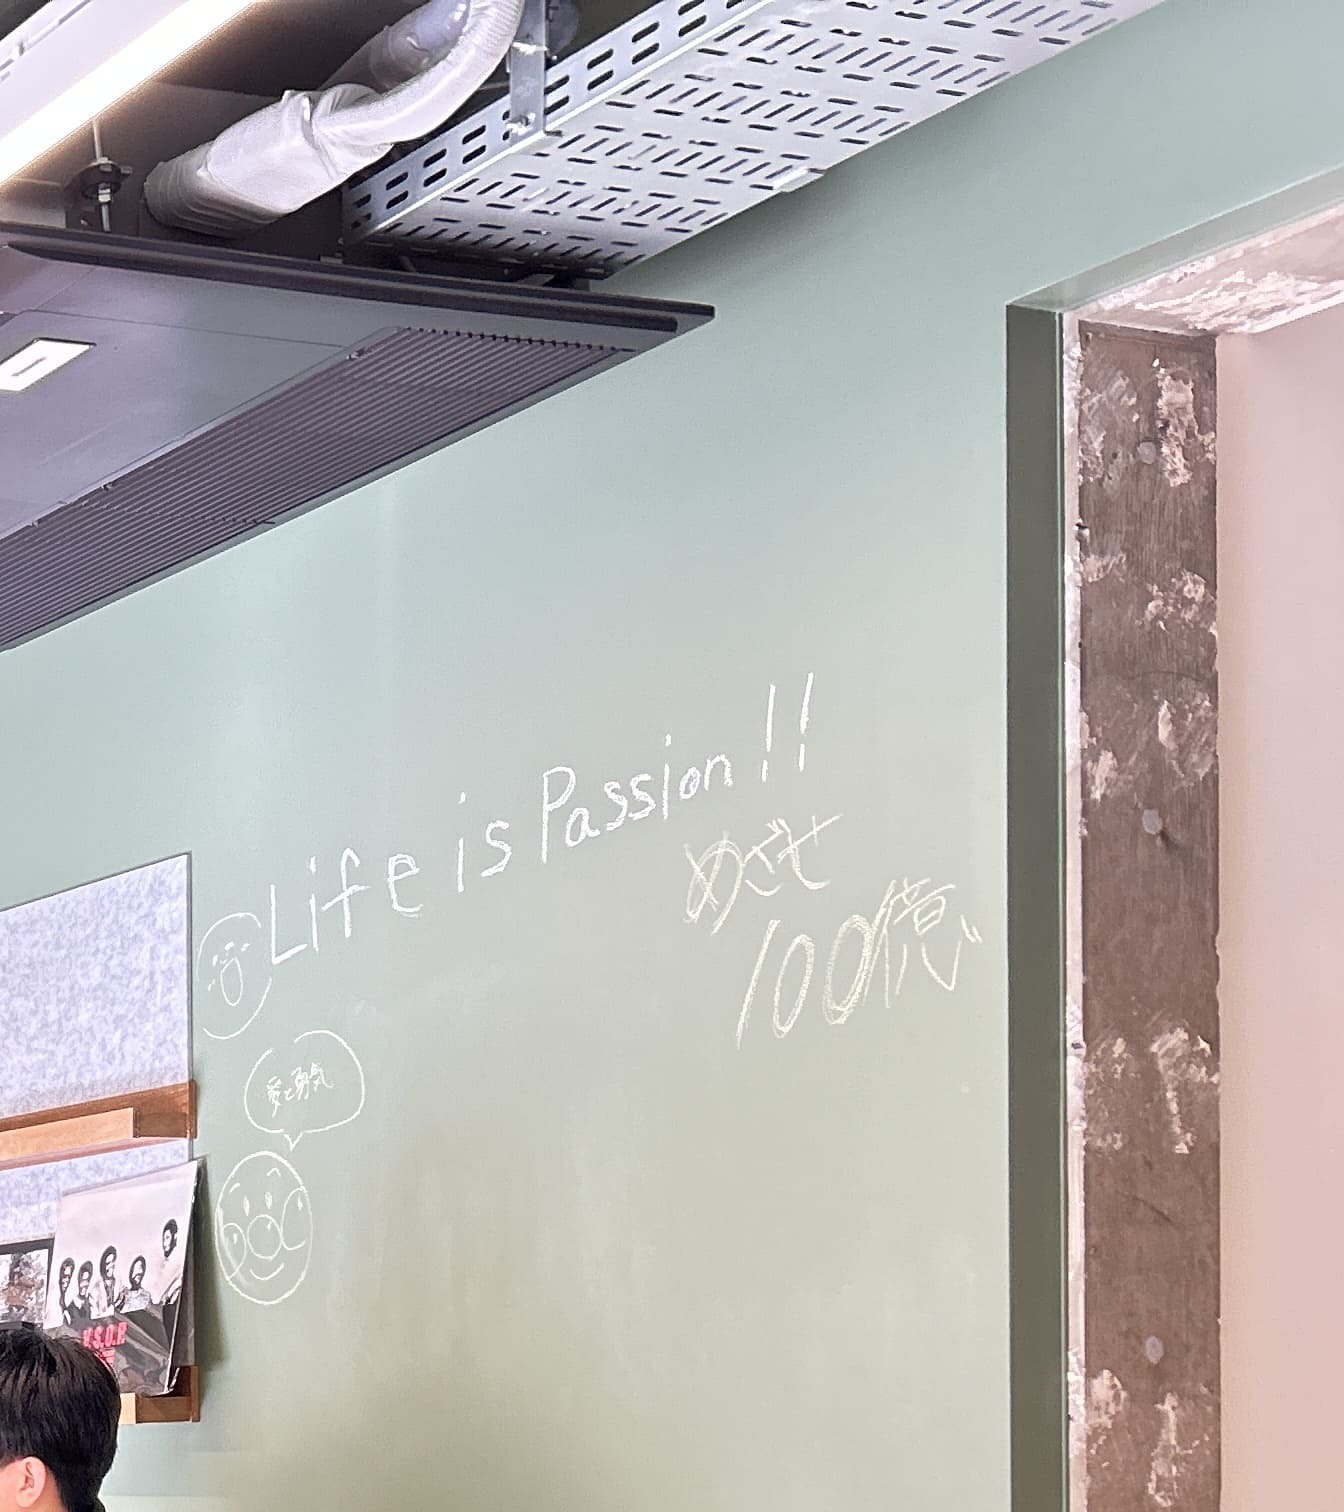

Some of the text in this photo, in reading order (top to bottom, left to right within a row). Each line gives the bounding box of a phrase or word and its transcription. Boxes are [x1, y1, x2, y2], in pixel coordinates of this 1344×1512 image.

[270, 848, 423, 966] Life
[457, 792, 513, 893] is
[541, 734, 734, 865] Passion
